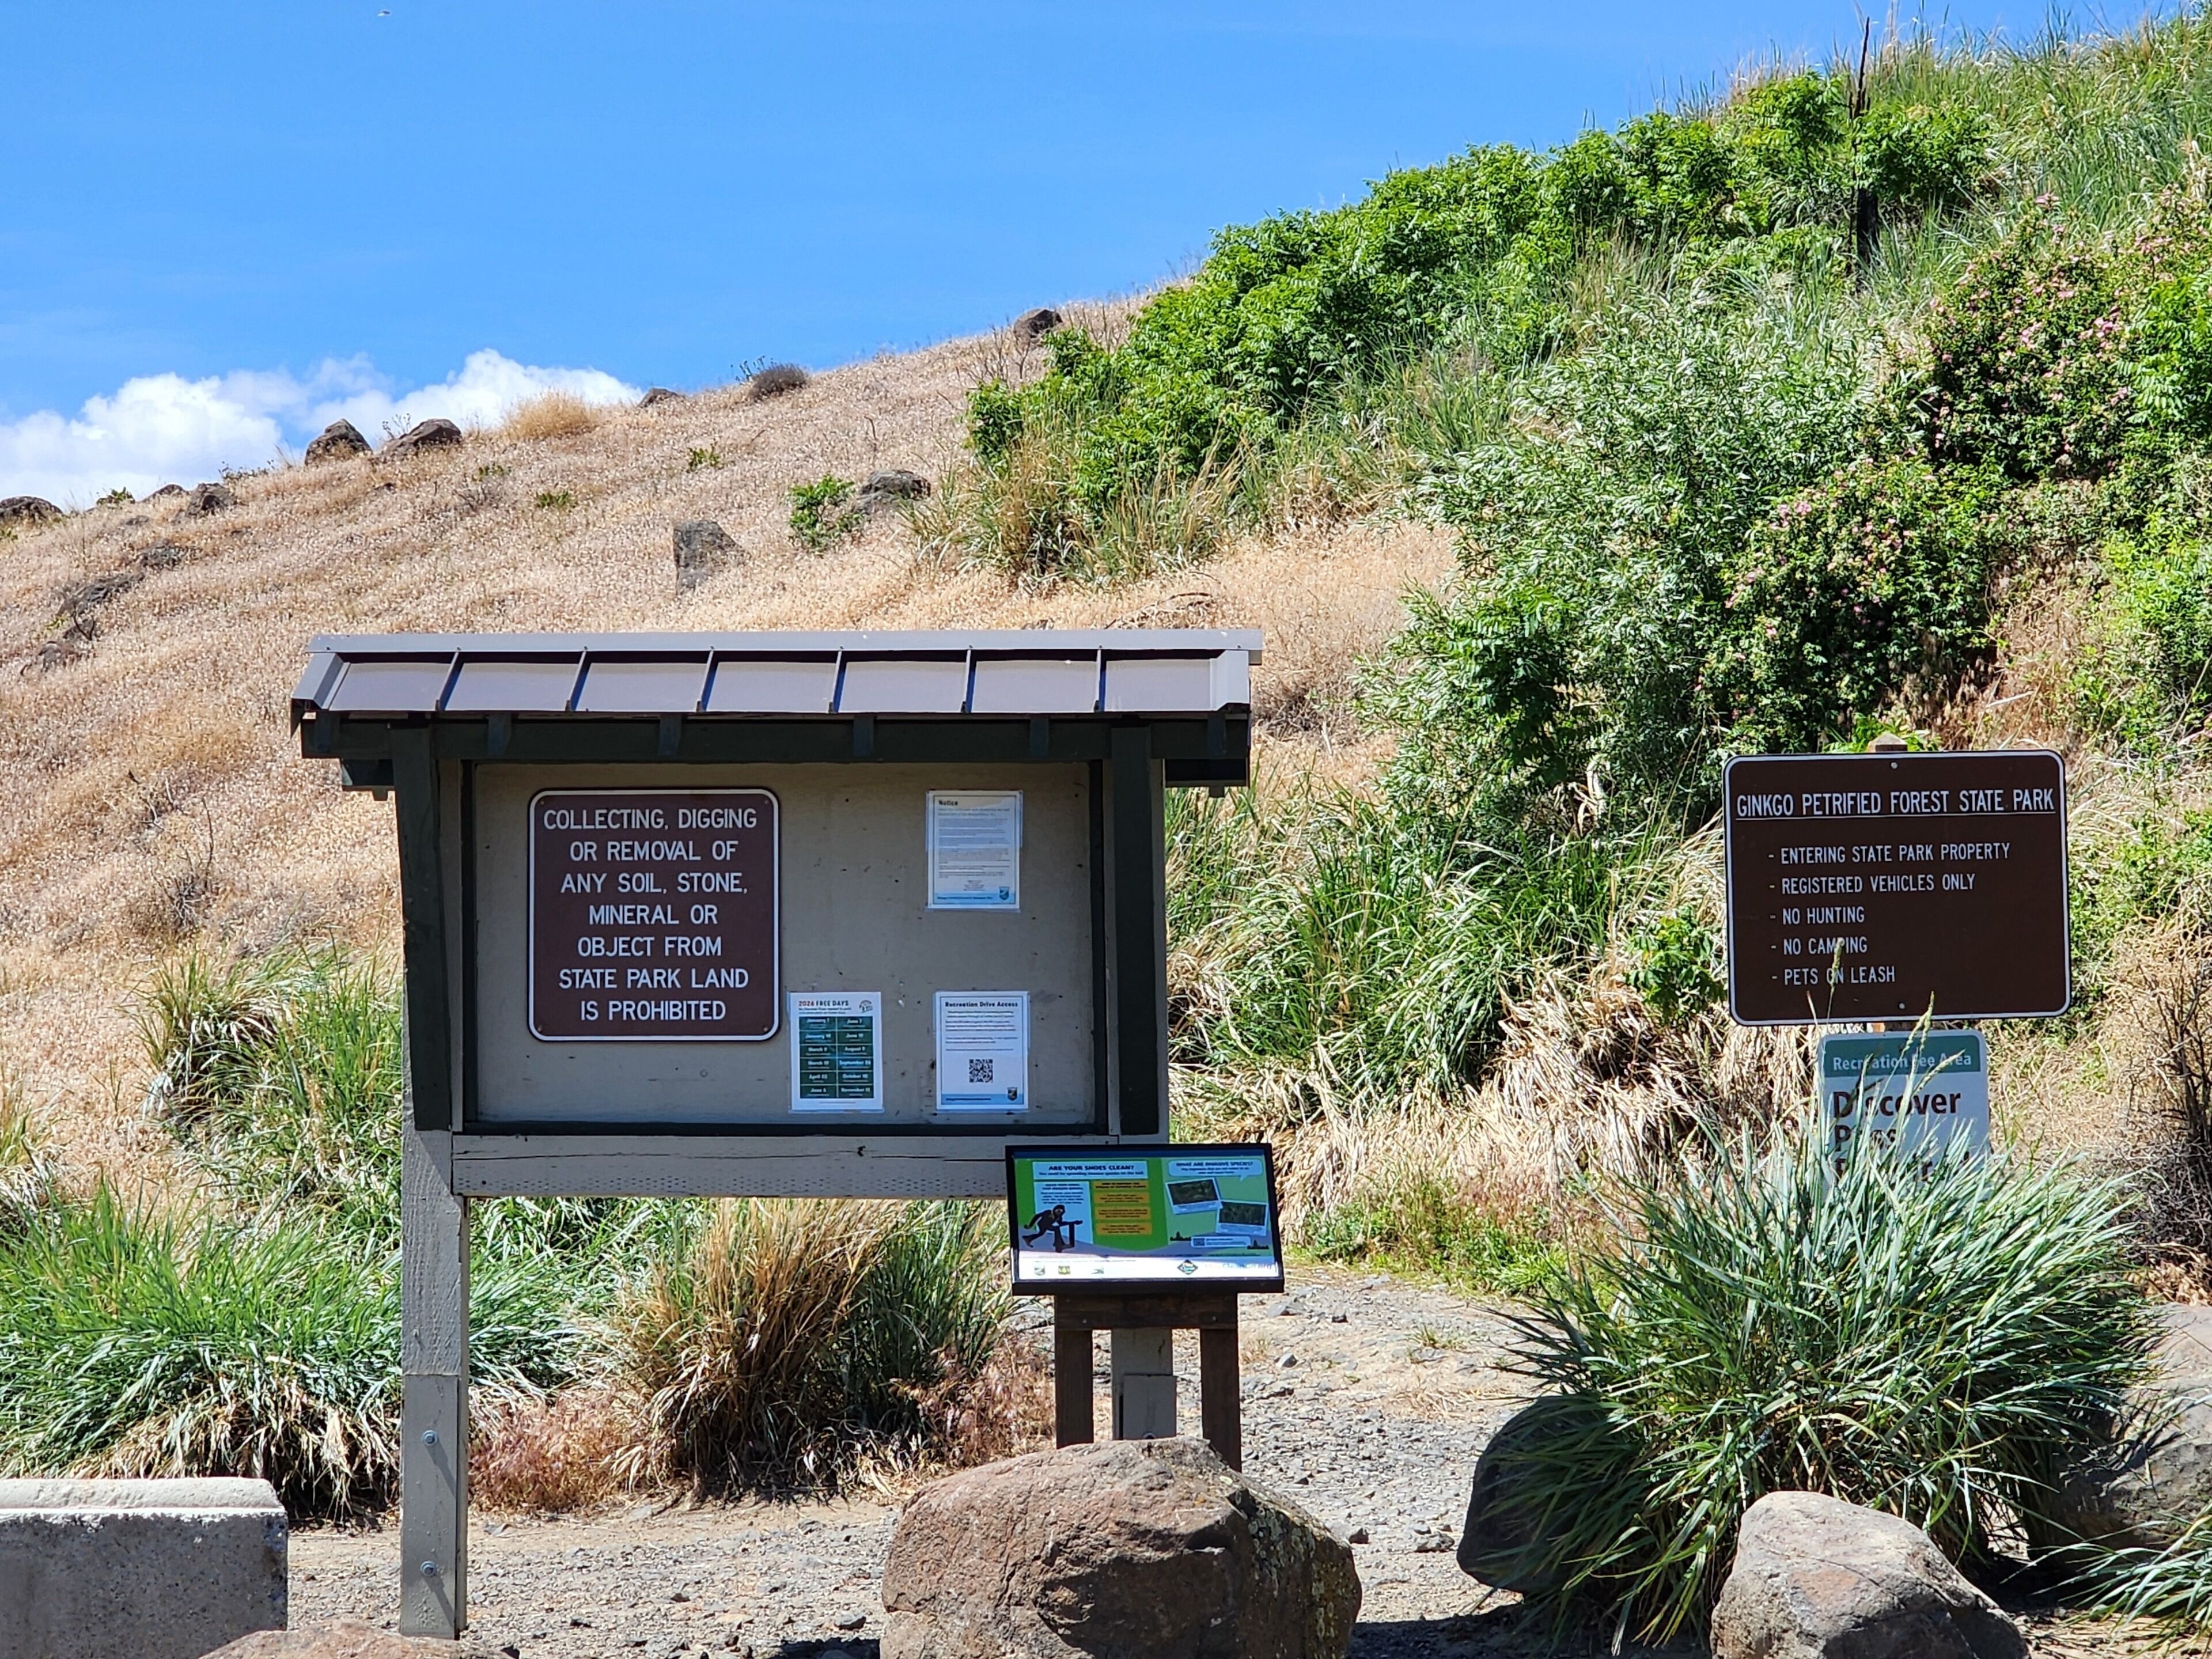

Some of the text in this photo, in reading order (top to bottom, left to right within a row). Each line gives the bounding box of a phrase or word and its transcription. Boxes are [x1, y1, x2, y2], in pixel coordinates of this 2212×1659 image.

[1737, 787, 2054, 817] GINKGO PETRIFIED FOREST STATE PARK
[544, 808, 757, 831] COLLECTING, DIGGING
[570, 840, 738, 861] OR REMOVAL OF
[1781, 846, 1845, 864] ENTERING
[1852, 845, 1892, 862] STATE
[1899, 844, 1934, 861] PARK
[1941, 843, 2010, 860] PROPERTY
[560, 872, 748, 895] ANY SOIL, STONE,
[1782, 876, 1862, 895] REGISTERED
[1870, 874, 1934, 892] VEHICLES
[1942, 873, 1976, 891] ONLY
[589, 904, 718, 925] MINERAL OR
[1782, 908, 1800, 925] NO
[1807, 906, 1865, 924] HUNTING
[578, 936, 721, 957] OBJECT FROM
[1783, 938, 1801, 955] NO
[559, 968, 749, 988] STATE PARK LAND
[1785, 968, 1818, 985] PETS
[1826, 967, 1844, 985] ON
[1851, 966, 1895, 984] LEASH
[581, 1000, 726, 1021] IS PROHIBITED
[1832, 1054, 1908, 1071] Recration
[1940, 1052, 1972, 1068] Aea
[1832, 1091, 1961, 1119] Dscover
